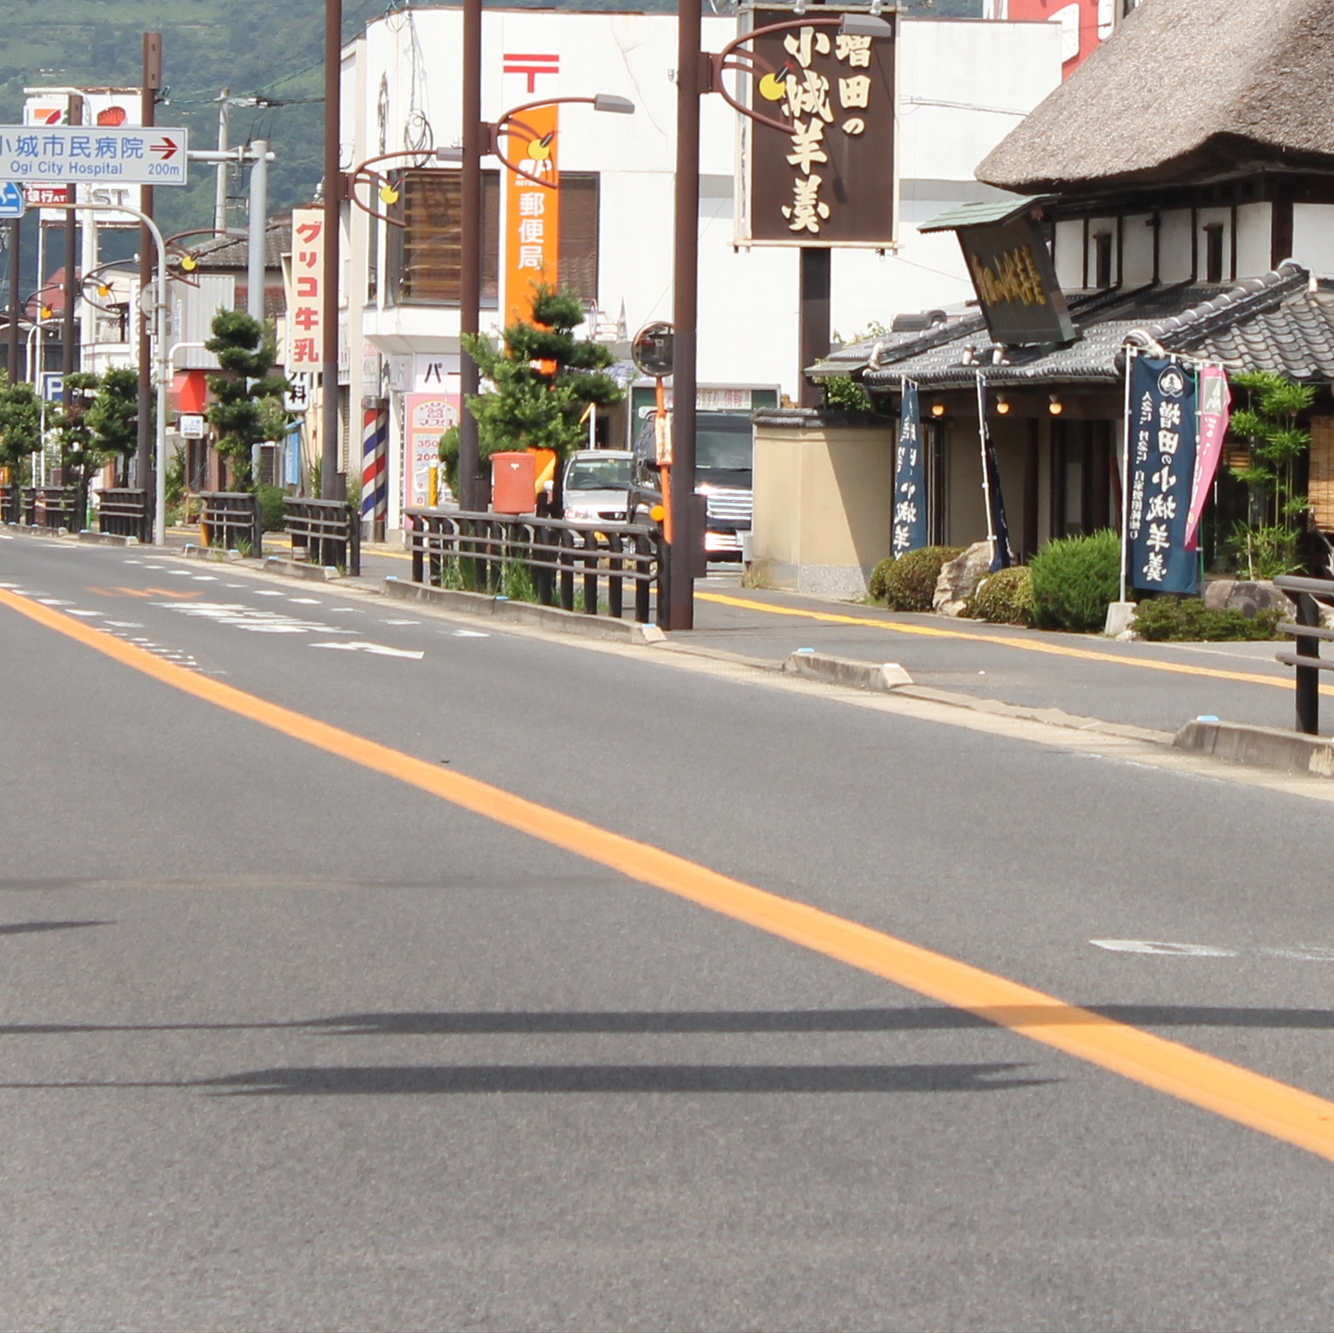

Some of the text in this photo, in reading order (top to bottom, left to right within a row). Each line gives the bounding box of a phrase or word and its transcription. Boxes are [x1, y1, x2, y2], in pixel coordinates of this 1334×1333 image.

[781, 26, 835, 234] 小城羊羹
[835, 34, 872, 136] 増田の
[10, 161, 180, 177] Ogi City Hospital 200m
[517, 191, 546, 271] 郵便局
[294, 220, 322, 363] グリコ牛乳
[47, 377, 64, 400] P
